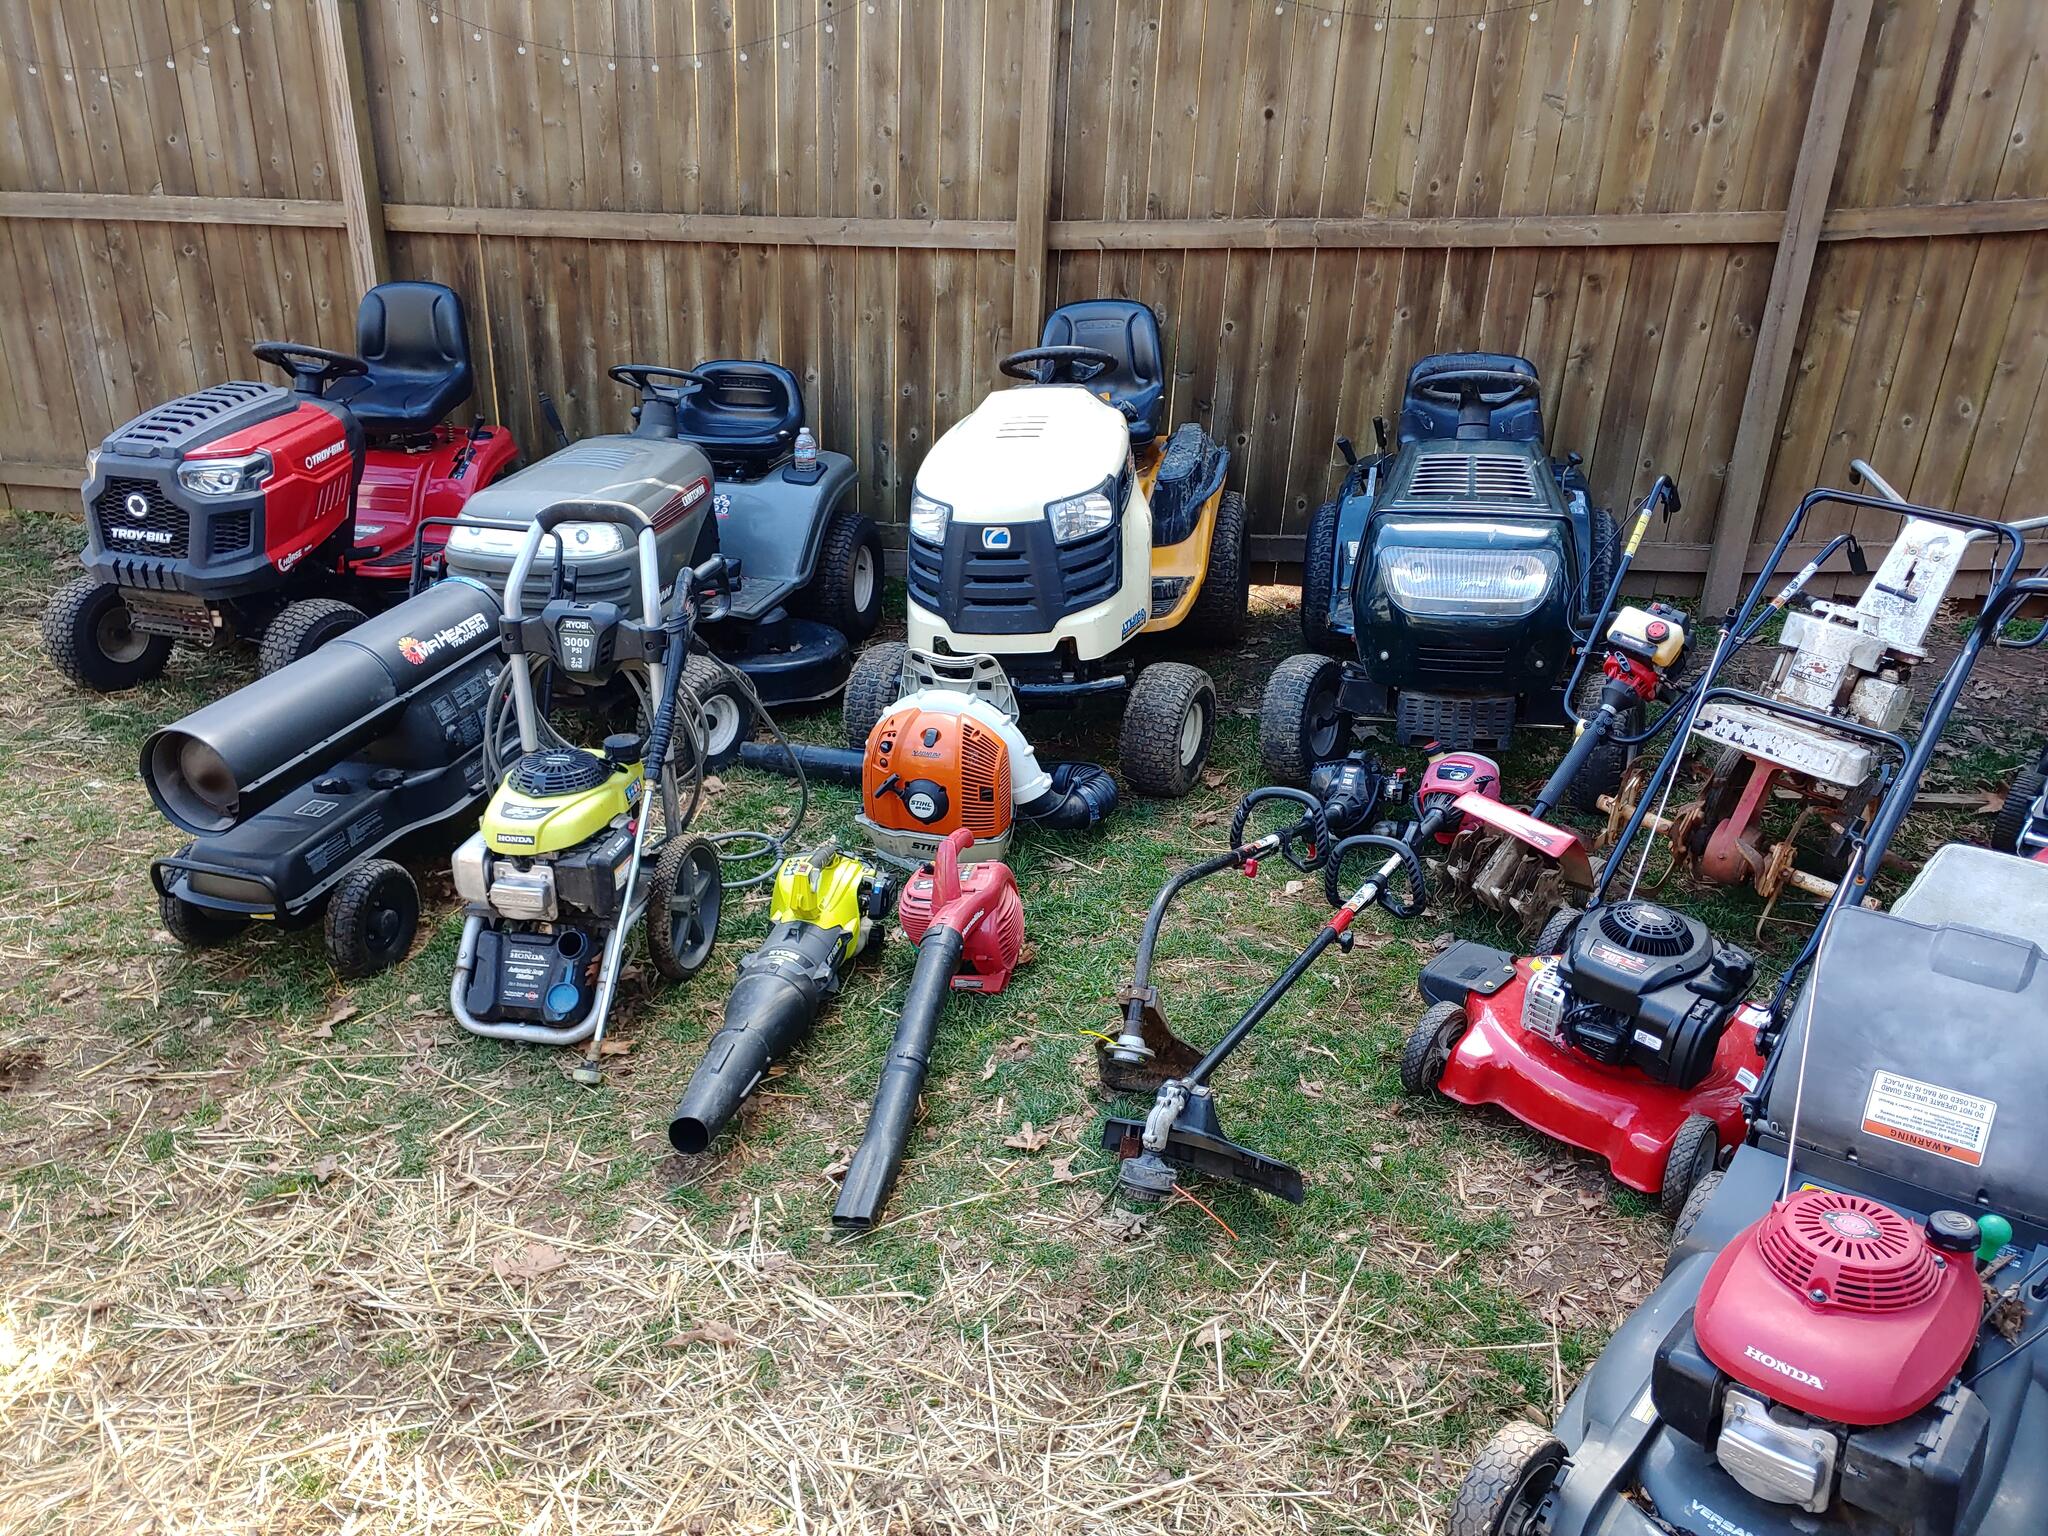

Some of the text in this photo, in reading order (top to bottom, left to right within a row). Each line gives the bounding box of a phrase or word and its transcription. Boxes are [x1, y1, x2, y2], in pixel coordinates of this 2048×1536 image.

[311, 440, 346, 466] TROY-BILT
[111, 527, 173, 544] TROY-BILT
[434, 612, 486, 648] HEATER
[476, 622, 489, 634] BTU
[565, 620, 589, 629] RYOBI
[564, 637, 590, 648] 3000
[498, 835, 533, 844] HONDA
[912, 842, 940, 853] STIH
[768, 949, 800, 960] RYOBI
[1883, 1077, 1904, 1088] PLACE
[1881, 1084, 1902, 1095] GUARD
[1922, 1088, 1937, 1097] BAG
[1903, 1091, 1928, 1102] UNLESS
[1939, 1092, 1949, 1100] OR
[1930, 1098, 1957, 1111] OPERATE
[1950, 1096, 1978, 1108] CLOSED
[1960, 1106, 1973, 1115] NOT
[1889, 1129, 1941, 1151] WARNING
[1744, 1345, 1824, 1391] HONDA
